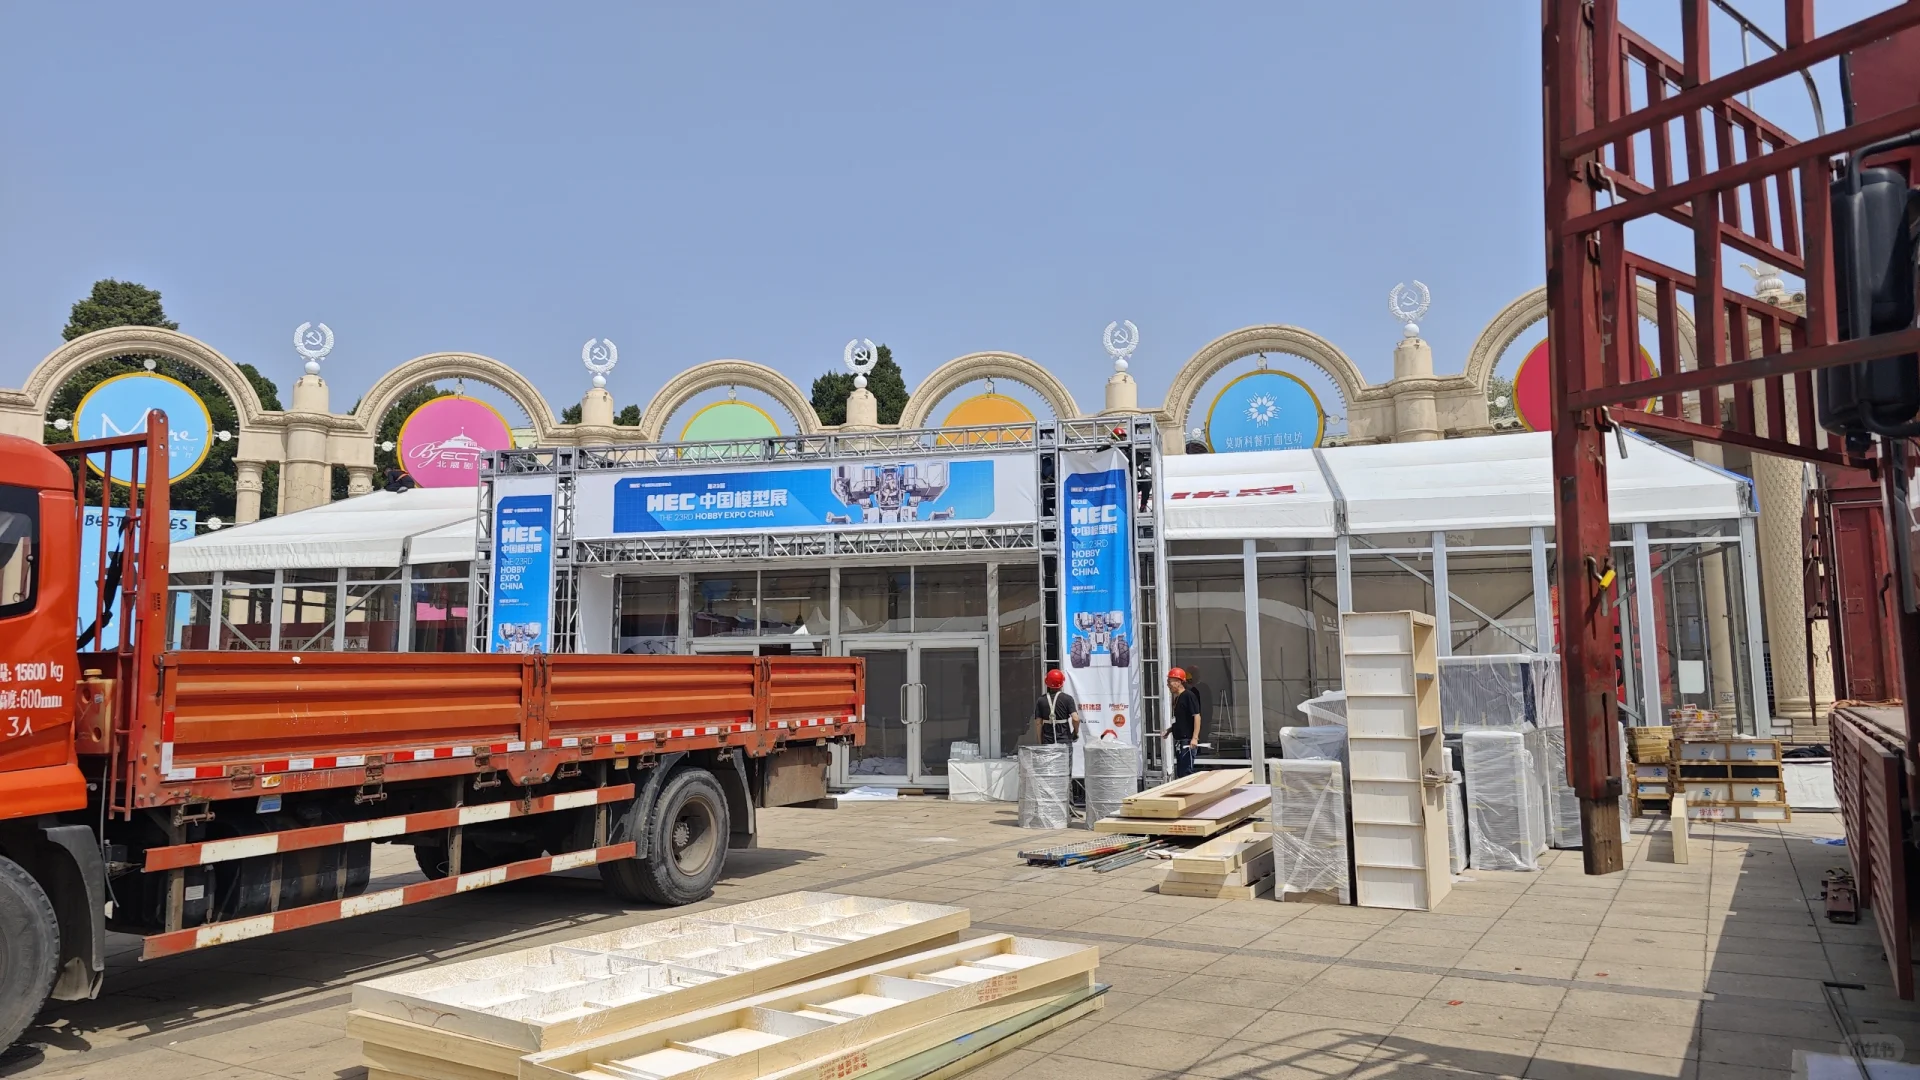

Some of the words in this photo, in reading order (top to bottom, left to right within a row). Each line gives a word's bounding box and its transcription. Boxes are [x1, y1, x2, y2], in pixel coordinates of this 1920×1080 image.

[1225, 431, 1303, 449] 莫斯科餐厅面包坊
[647, 493, 696, 512] HEC
[699, 489, 788, 510] 中国模型展
[674, 513, 694, 521] 23RD
[695, 511, 723, 520] HOBBY
[724, 510, 746, 519] EXPO
[747, 510, 775, 518] CHINA
[1070, 504, 1117, 525] HEC
[501, 526, 543, 543] HEC
[1071, 523, 1118, 536] 中国模型展
[501, 543, 542, 554] 中国模型展
[1072, 540, 1086, 549] THE
[1087, 539, 1109, 548] 23RD
[1071, 549, 1101, 558] HOBBY
[501, 558, 514, 566] THE
[515, 557, 533, 566] 23RD
[1071, 558, 1095, 567] EXPO
[500, 566, 526, 574] HOBBY
[1071, 567, 1100, 577] CHINA
[500, 583, 524, 591] CHINA
[15, 662, 46, 681] 15600
[50, 661, 64, 682] kg
[6, 716, 34, 737] 3人
